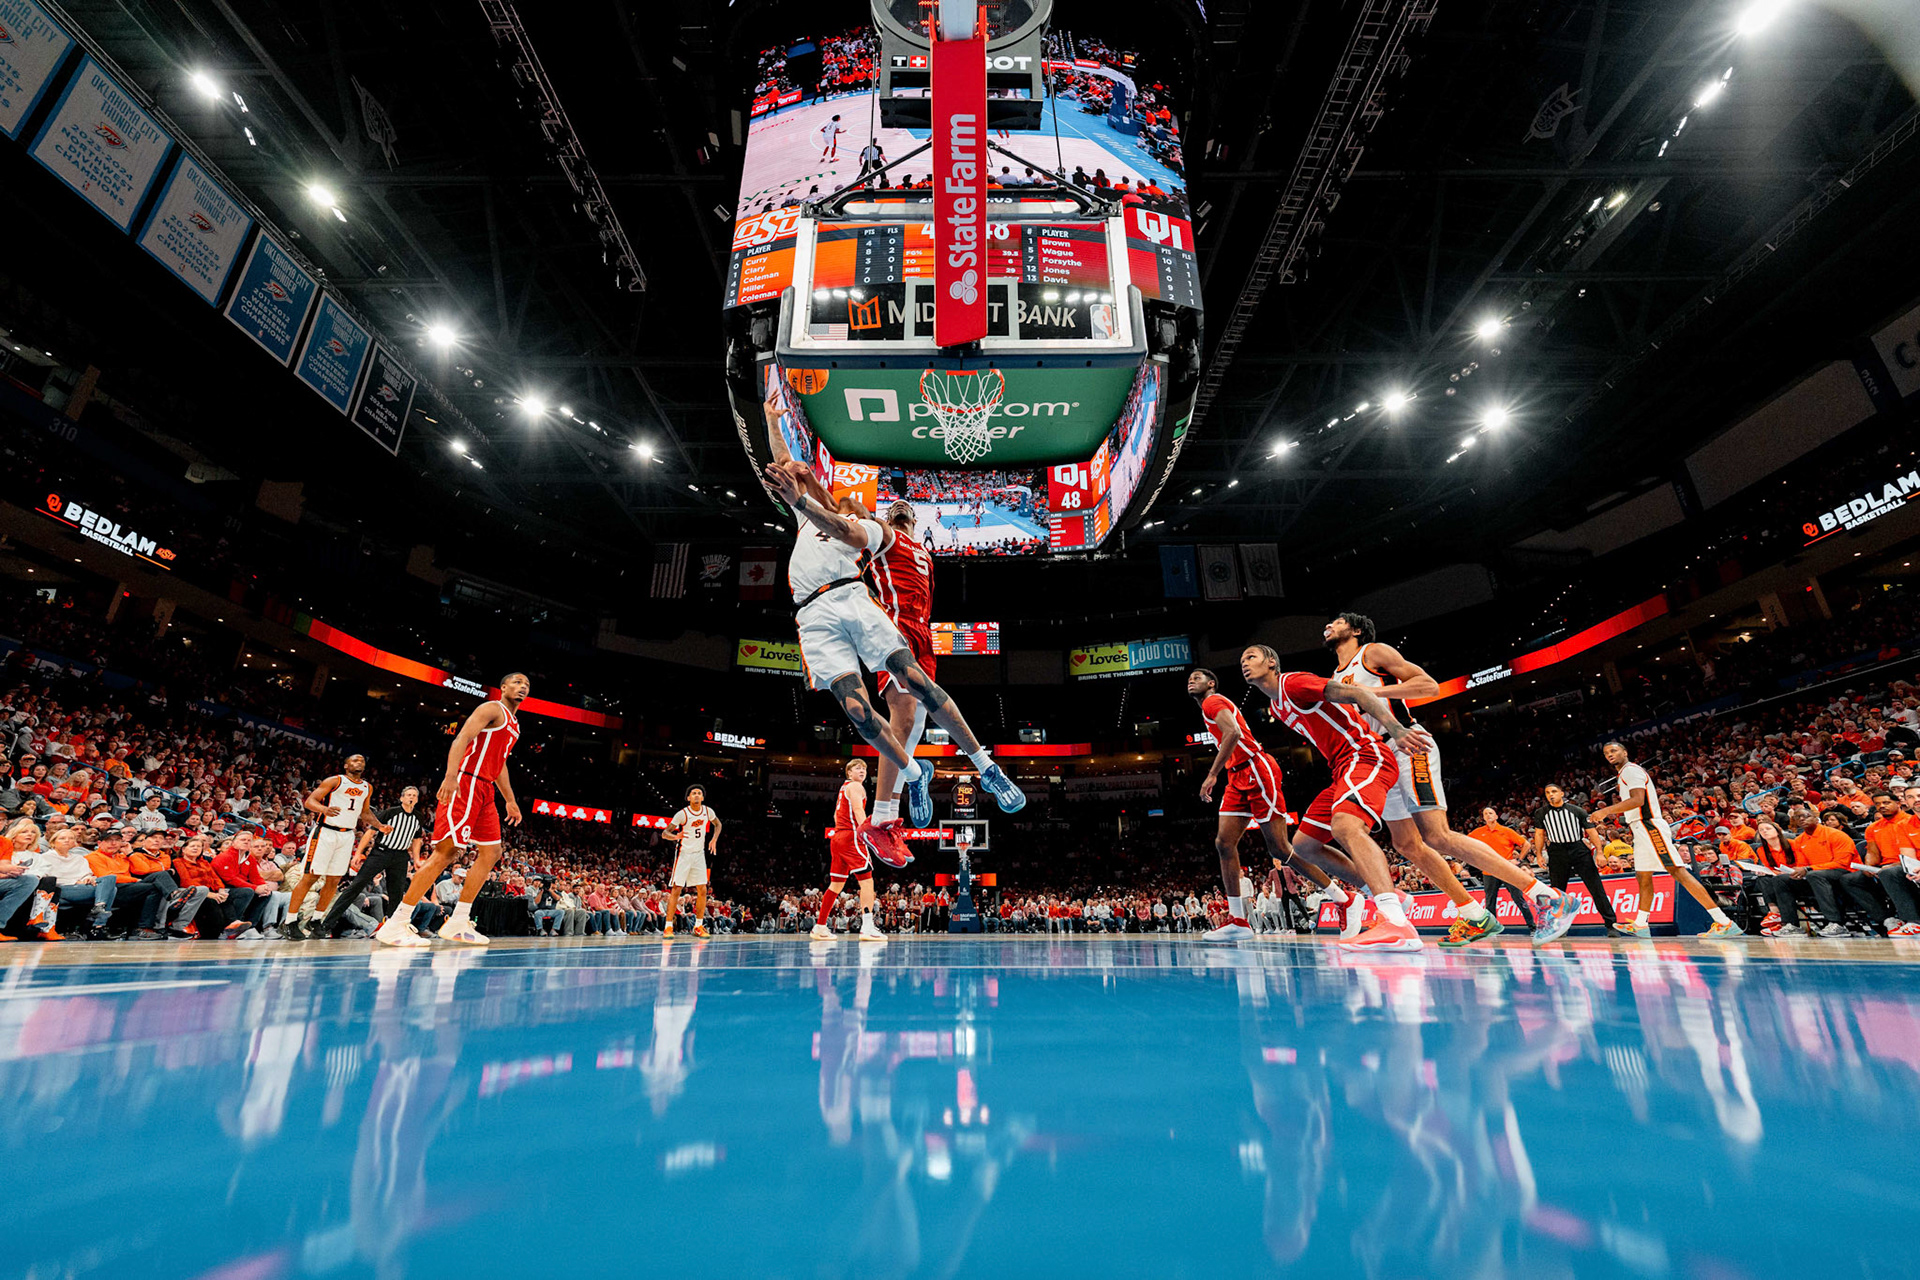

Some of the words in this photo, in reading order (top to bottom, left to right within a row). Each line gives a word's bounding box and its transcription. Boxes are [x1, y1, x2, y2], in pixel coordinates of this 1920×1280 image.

[986, 56, 1032, 70] SOT
[91, 74, 141, 126] OKLAHOMA
[140, 121, 160, 144] CITY
[100, 100, 142, 145] THUNDER
[62, 127, 134, 192] NORTHWEST
[71, 124, 134, 182] 2023-2024
[55, 144, 126, 206] CHAMPIONS
[68, 144, 121, 192] DIVISION
[187, 167, 225, 210] OKLAHOMA
[226, 205, 242, 226] CITY
[194, 190, 228, 228] THUNDER
[162, 218, 220, 272] NORTHWEST
[170, 215, 220, 260] 2024-2025
[921, 224, 935, 240] 4
[1042, 228, 1070, 238] PLAYER
[1042, 238, 1070, 248] Brown
[157, 234, 213, 284] CHAMPIONS
[168, 233, 210, 272] DIVISION
[746, 256, 768, 266] Curry
[747, 244, 772, 256] PLAYER
[1042, 248, 1074, 257] Wague
[1042, 257, 1082, 267] Forsythe
[1161, 248, 1172, 256] PTS
[264, 242, 296, 277] OKLAHOMA
[294, 272, 310, 292] CITY
[270, 262, 298, 294] THUNDER
[744, 266, 766, 275] Clary
[744, 272, 779, 284] Coleman
[1043, 266, 1070, 275] Jones
[1043, 276, 1068, 284] Davis
[740, 290, 778, 303] Coleman
[742, 283, 766, 294] Miller
[241, 296, 291, 342] CONFERENCE
[251, 294, 287, 330] WESTERN
[253, 288, 290, 324] 2011-2012
[241, 305, 286, 346] CHAMPIONS
[326, 303, 354, 334] OKLAHOMA
[352, 327, 364, 344] CITY
[332, 320, 355, 347] THUNDER
[308, 354, 350, 392] CONFERENCE
[316, 353, 346, 381] WESTERN
[318, 346, 350, 376] 2024-2025
[378, 353, 402, 380] OKLAHOMA
[400, 374, 412, 389] CITY
[308, 364, 346, 396] CHAMPIONS
[384, 368, 403, 392] THUNDER
[364, 406, 396, 436] CHAMPIONS
[376, 408, 388, 422] NBA
[49, 417, 78, 442] 310
[911, 426, 1025, 439] ceer
[1098, 474, 1106, 495] 41
[1061, 491, 1081, 509] 48
[1819, 470, 1920, 532] BEDLAM
[1844, 498, 1906, 531] BASKETBALL
[64, 502, 157, 556] BEDLAM
[80, 526, 134, 557] BASKETBALL
[702, 554, 730, 564] THUNDER
[912, 551, 929, 576] 5
[1132, 644, 1160, 666] LOUD
[1164, 643, 1189, 660] CITY
[714, 732, 756, 746] BEDLAM
[348, 798, 355, 811] 1
[695, 828, 702, 838] 5
